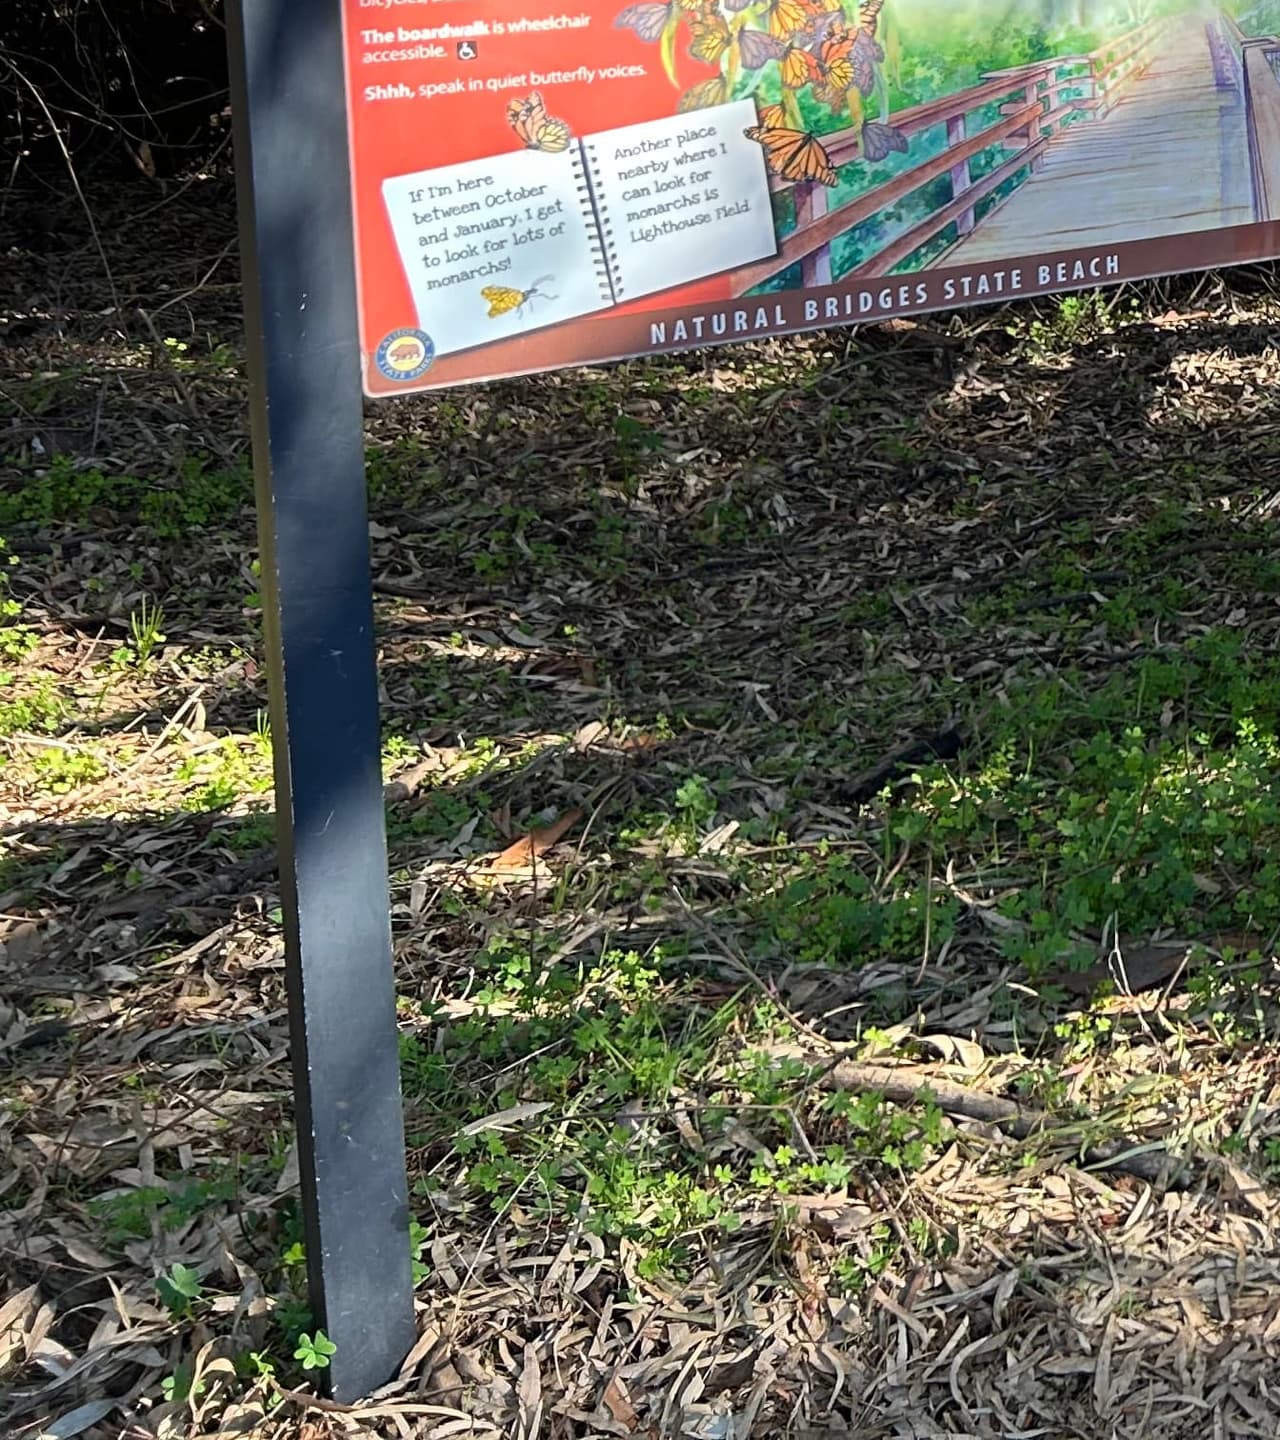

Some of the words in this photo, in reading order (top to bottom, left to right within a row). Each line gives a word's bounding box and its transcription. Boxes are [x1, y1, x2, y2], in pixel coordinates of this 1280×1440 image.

[362, 43, 448, 64] accessible.
[364, 82, 415, 101] Shhh,
[418, 77, 465, 98] speak
[468, 77, 483, 91] in
[485, 74, 527, 92] quiet
[529, 65, 596, 85] butterfly
[597, 64, 647, 79] voices.
[614, 137, 671, 160] Another
[676, 126, 717, 148] place
[408, 188, 424, 203] If
[427, 186, 452, 198] I'm
[456, 175, 494, 192] here
[412, 201, 480, 225] between
[484, 184, 547, 207] October
[630, 213, 712, 242] Lighthouse
[715, 199, 752, 219] Field
[426, 256, 512, 290] monarchs!
[650, 305, 787, 345] NATURAL
[805, 284, 928, 321] BRIDGES
[943, 269, 1022, 299] STATE
[1038, 254, 1120, 285] BEACH
